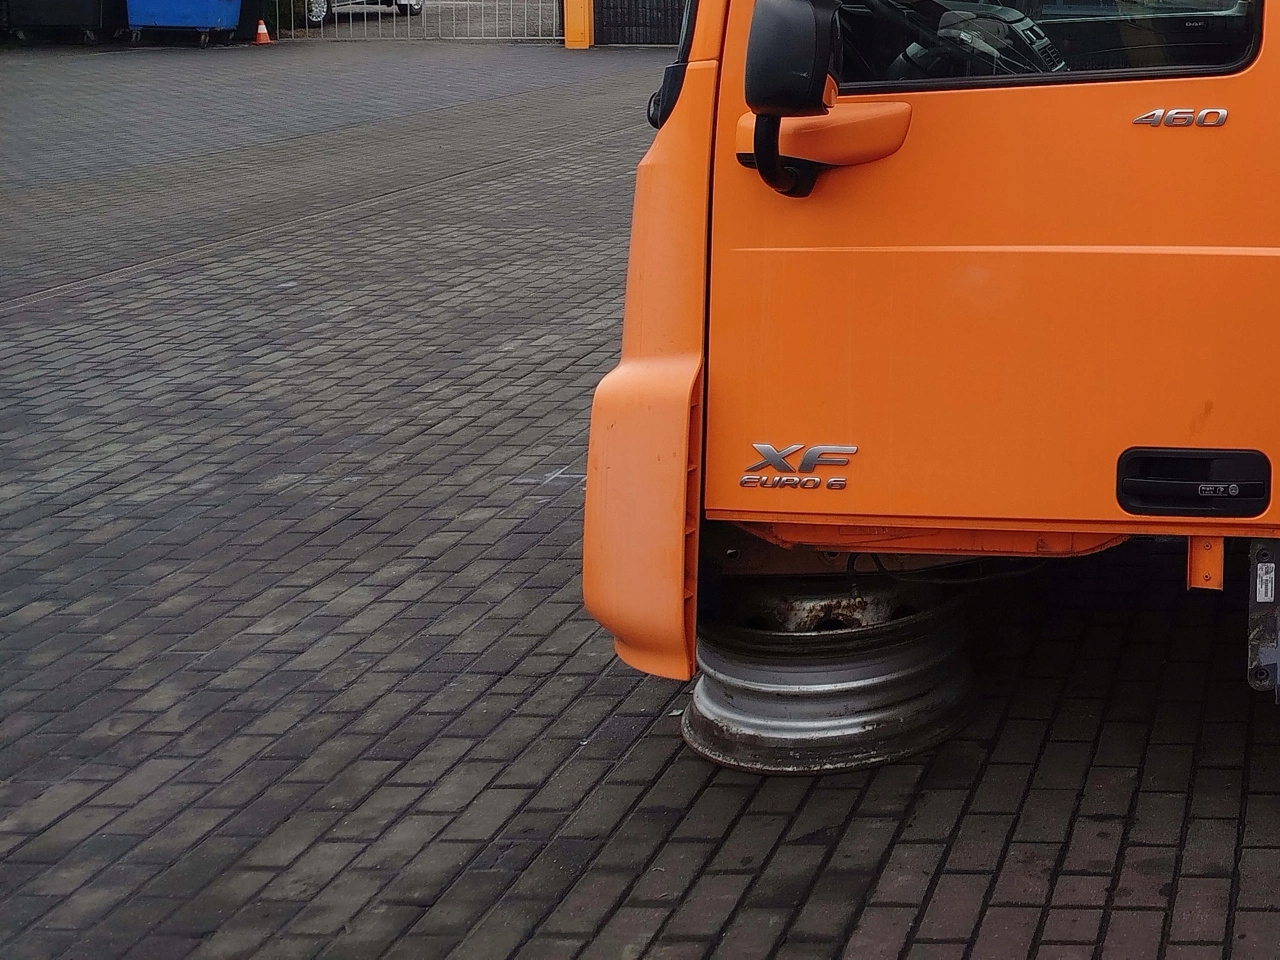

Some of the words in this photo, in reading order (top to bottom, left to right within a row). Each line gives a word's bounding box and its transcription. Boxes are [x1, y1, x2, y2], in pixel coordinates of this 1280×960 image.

[1132, 107, 1228, 127] 460
[744, 443, 858, 473] XF
[739, 475, 821, 489] EURO
[826, 477, 847, 490] 6
